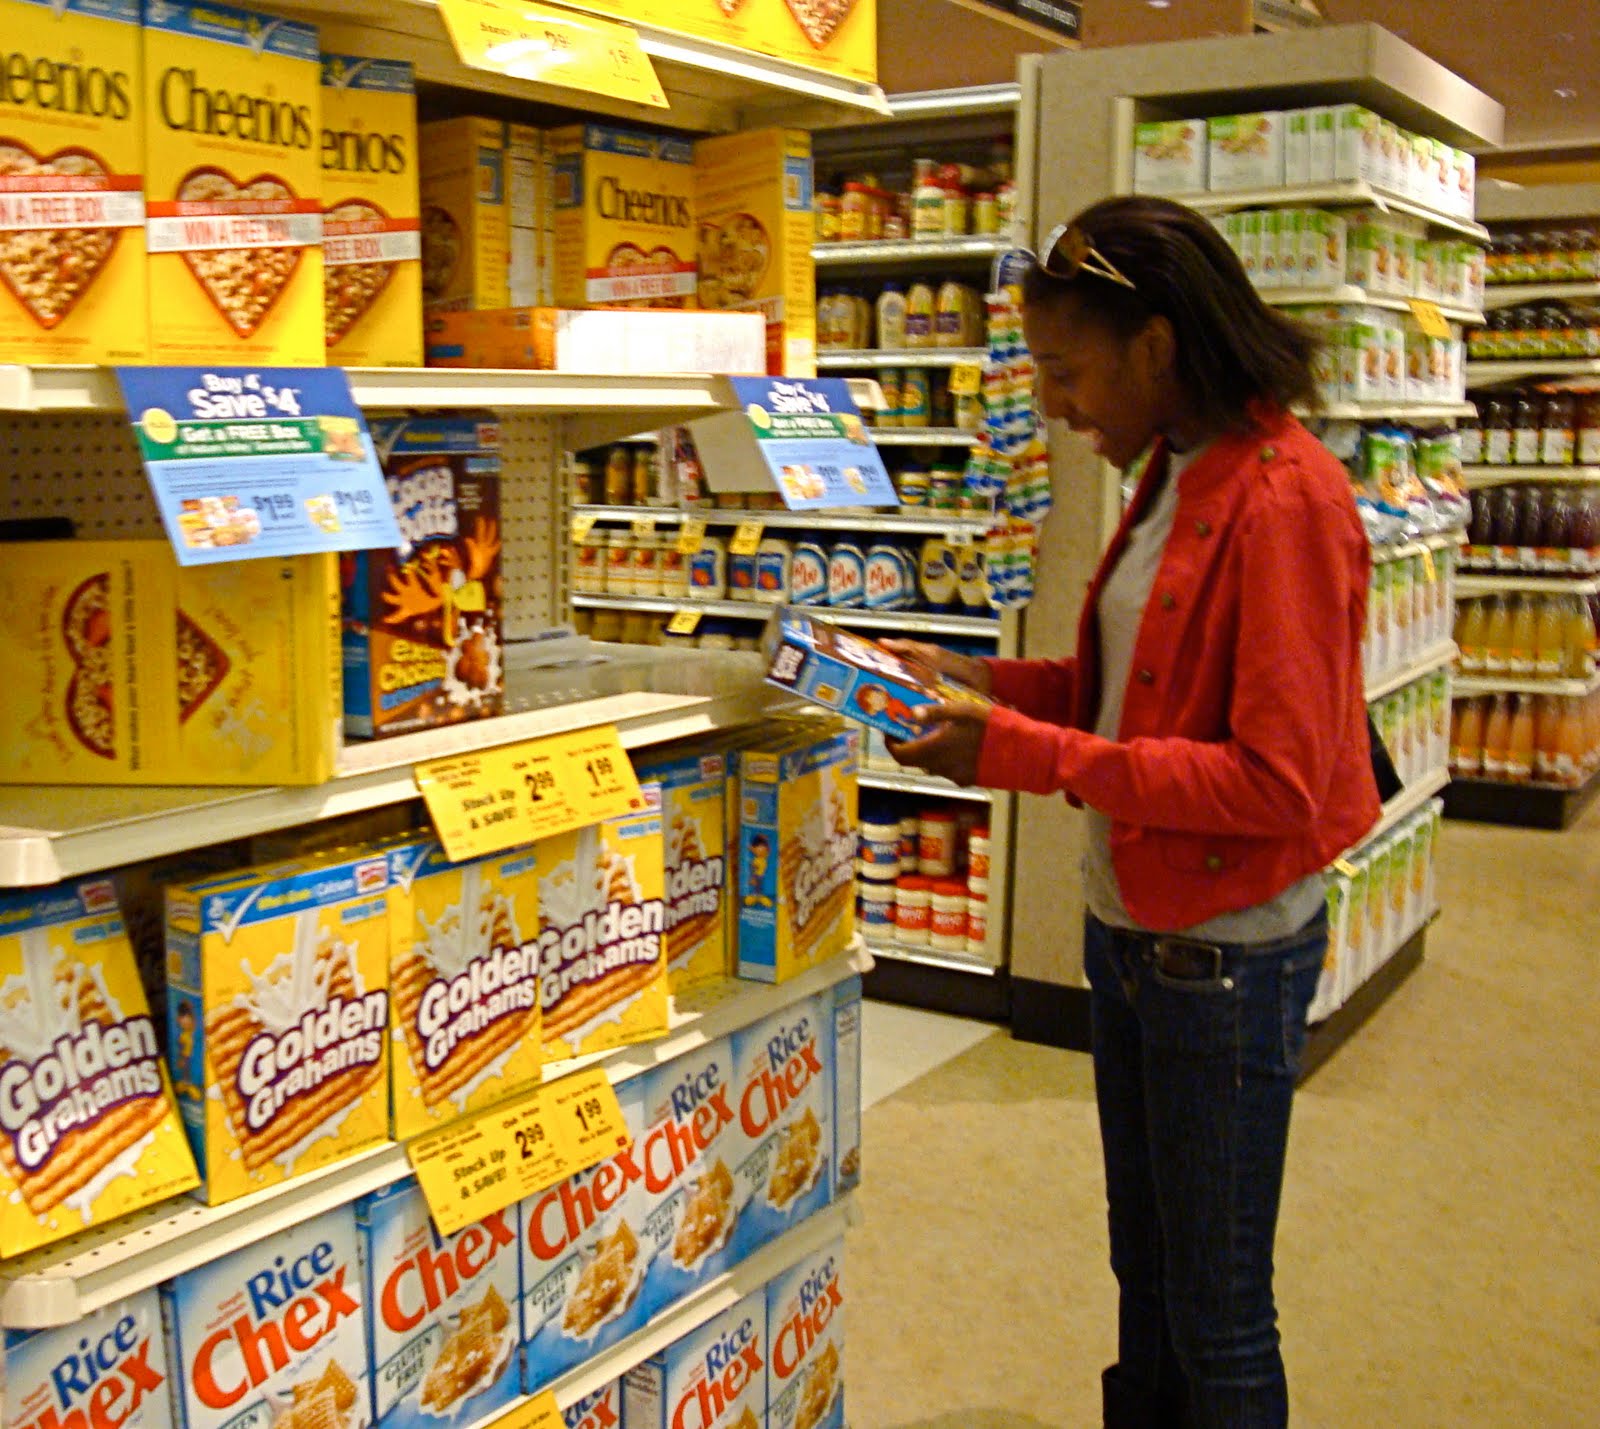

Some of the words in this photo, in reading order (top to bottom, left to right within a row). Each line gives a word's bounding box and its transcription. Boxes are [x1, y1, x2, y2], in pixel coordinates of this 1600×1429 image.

[0, 50, 131, 121] eerios
[159, 64, 312, 150] Cheerios
[321, 124, 406, 175] erios
[31, 197, 68, 224] FREE
[74, 197, 105, 223] BOX
[598, 176, 691, 228] Cheerios
[324, 241, 352, 261] REE
[353, 238, 382, 259] BOX
[187, 388, 267, 418] Save
[201, 373, 242, 394] Buy
[225, 424, 269, 440] FREE
[664, 858, 723, 902] lden
[539, 901, 664, 968] Golden
[419, 940, 540, 1037] Golden
[541, 937, 660, 1008] Grahams
[239, 990, 388, 1096] Golden
[426, 978, 536, 1069] Grahams
[768, 1017, 809, 1073] Rice
[0, 1016, 161, 1134] Golden
[248, 1031, 382, 1130] Grahams
[671, 1060, 719, 1124] Rice
[740, 1036, 823, 1139] Chex
[16, 1060, 161, 1168] Grahams
[644, 1083, 735, 1195] Chex
[453, 1156, 486, 1183] Stock
[490, 1148, 506, 1164] Up
[460, 1185, 470, 1200] &
[528, 1139, 643, 1262] Chex
[247, 1241, 336, 1321] Rice
[381, 1209, 516, 1334] Chex
[800, 1256, 835, 1315] Rice
[191, 1264, 362, 1410] Chex
[384, 1334, 433, 1383] GLUTEN
[706, 1318, 752, 1381] Rice
[773, 1273, 844, 1380] Chex
[51, 1314, 139, 1412] Rice
[672, 1336, 764, 1429] Chex
